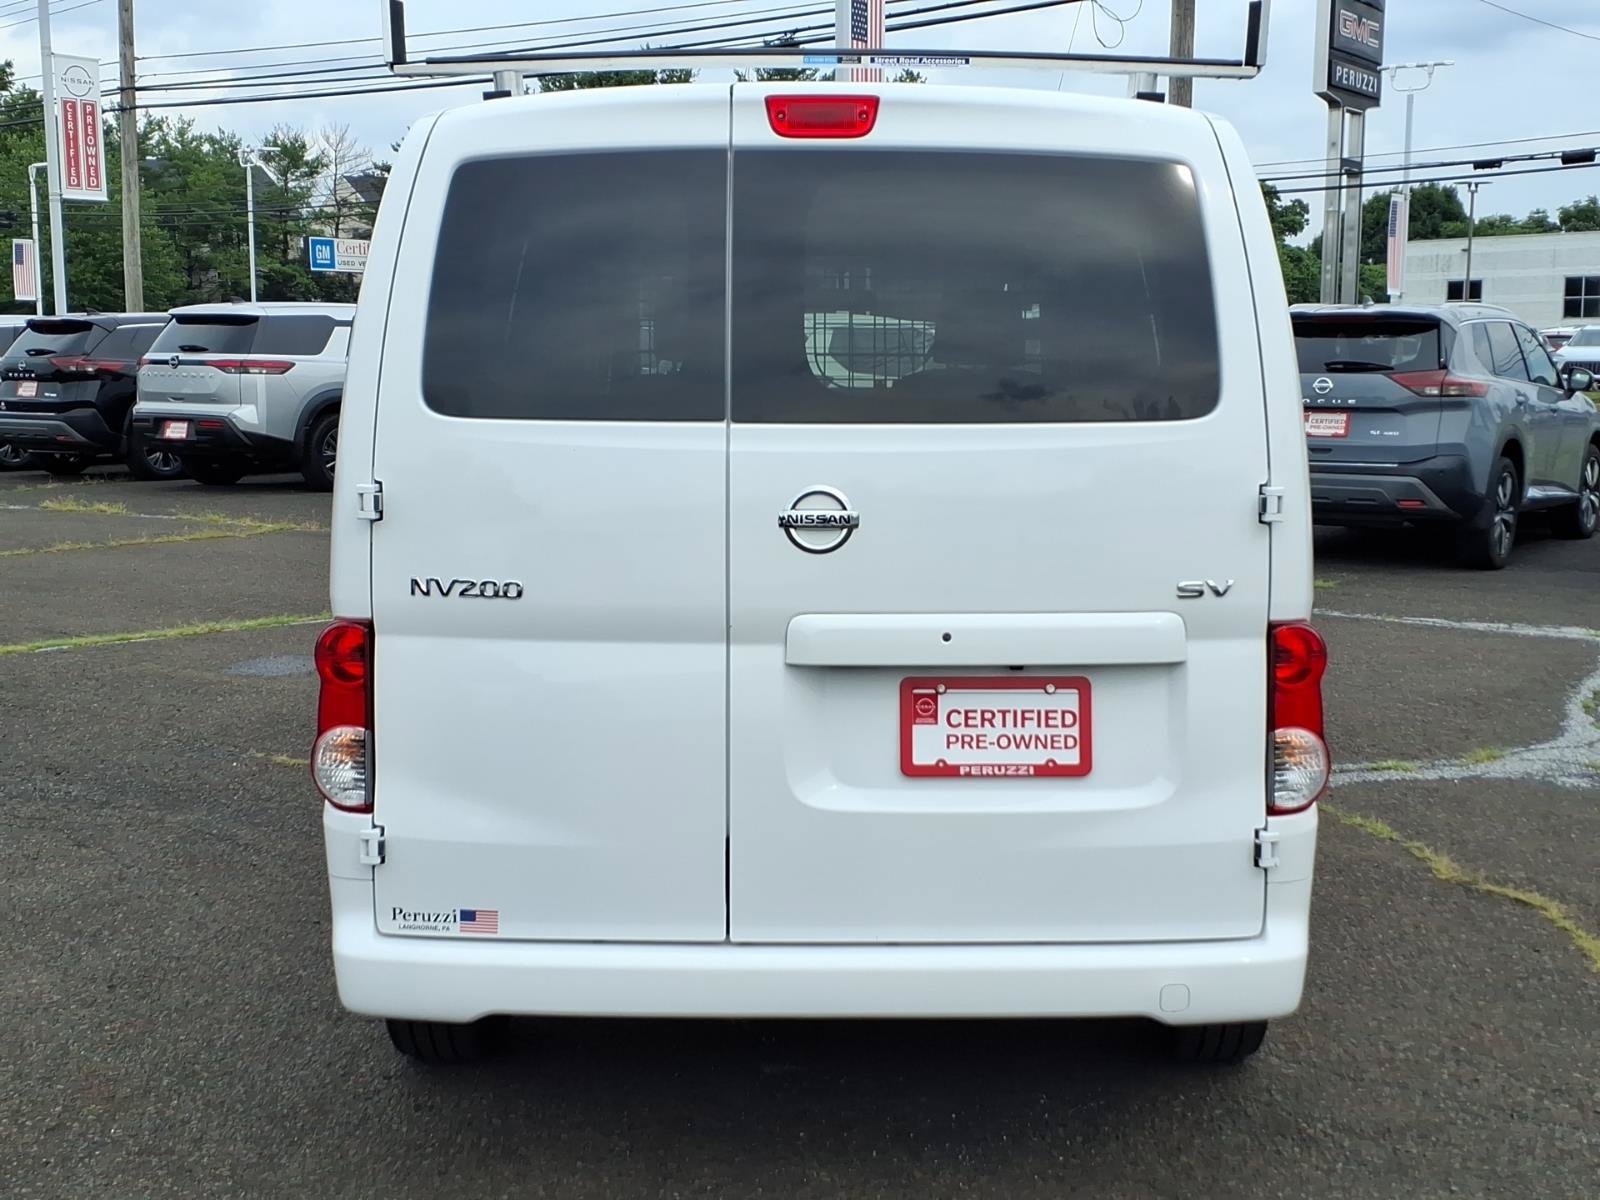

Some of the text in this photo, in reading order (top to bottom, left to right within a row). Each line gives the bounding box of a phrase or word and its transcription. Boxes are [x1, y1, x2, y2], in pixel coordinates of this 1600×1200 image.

[1340, 9, 1379, 48] GMC
[921, 57, 965, 65] Accessories
[61, 77, 94, 86] NISSAN
[1336, 65, 1377, 93] PERUZZI
[66, 103, 77, 185] CERTIFIED
[86, 105, 97, 186] PREOWNED
[315, 244, 330, 260] GM
[786, 514, 851, 525] NISSAN
[410, 578, 523, 600] NV200
[1176, 579, 1234, 599] SV
[945, 709, 1078, 729] CERTIFIED
[946, 733, 1078, 750] PRE-OWNED
[959, 764, 1035, 775] PERUZZI
[392, 907, 457, 923] Peruzzi
